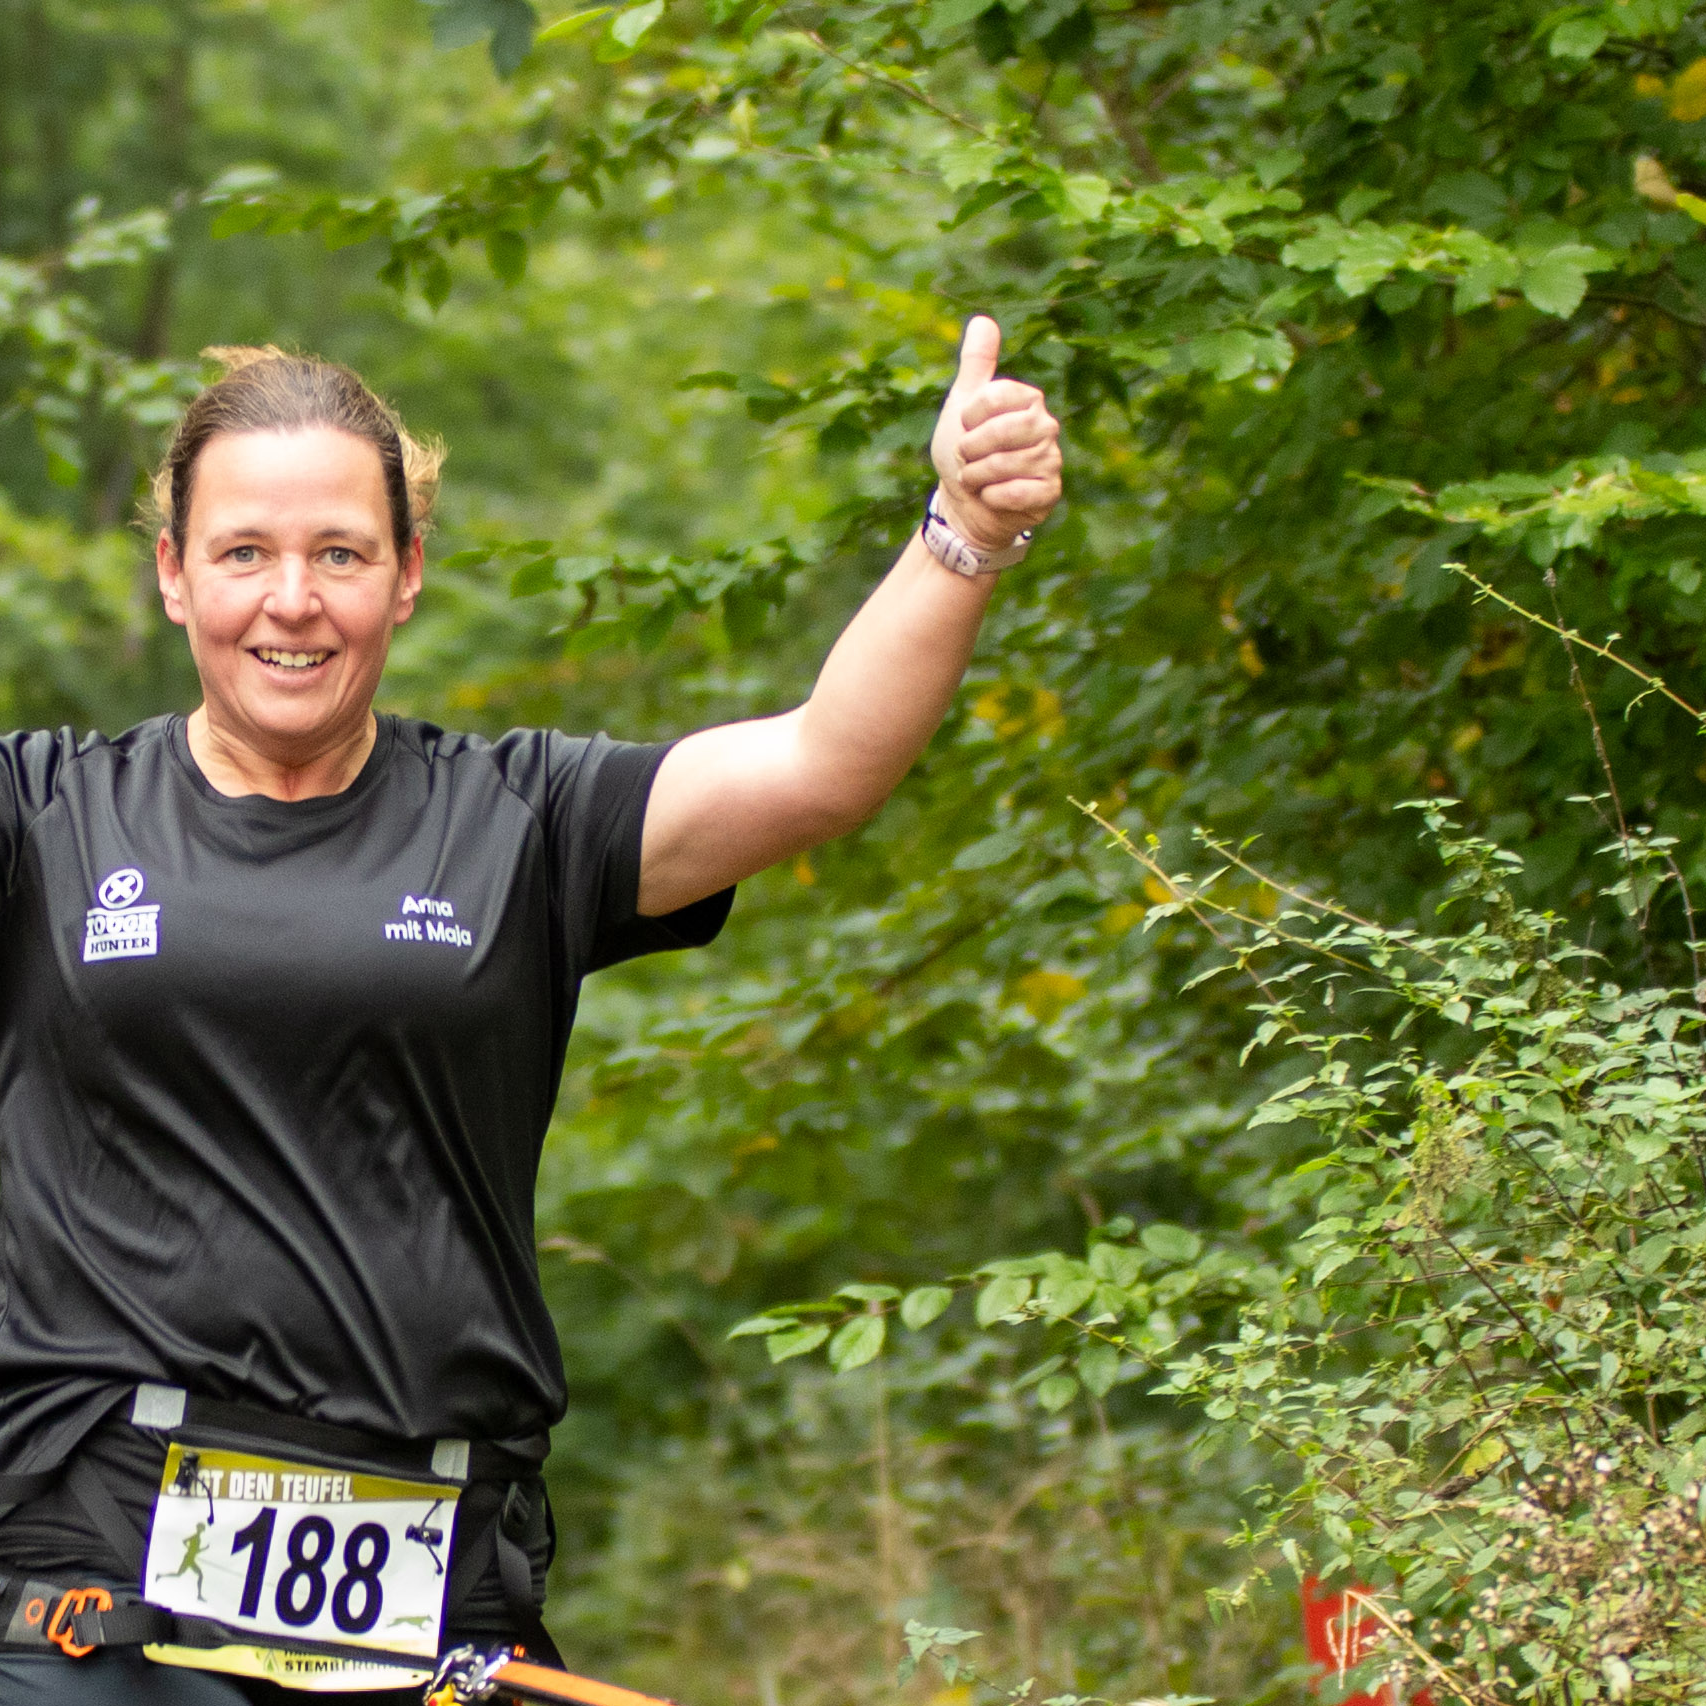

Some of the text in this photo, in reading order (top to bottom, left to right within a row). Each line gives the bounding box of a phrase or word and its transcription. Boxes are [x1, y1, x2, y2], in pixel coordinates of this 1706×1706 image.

[401, 894, 454, 918] Anna
[86, 906, 159, 937] TOUGH
[385, 919, 472, 947] mit Maja
[90, 937, 151, 954] HUNTER
[228, 1470, 275, 1501] DEN
[280, 1472, 354, 1503] TEUFEL
[230, 1505, 391, 1636] 188
